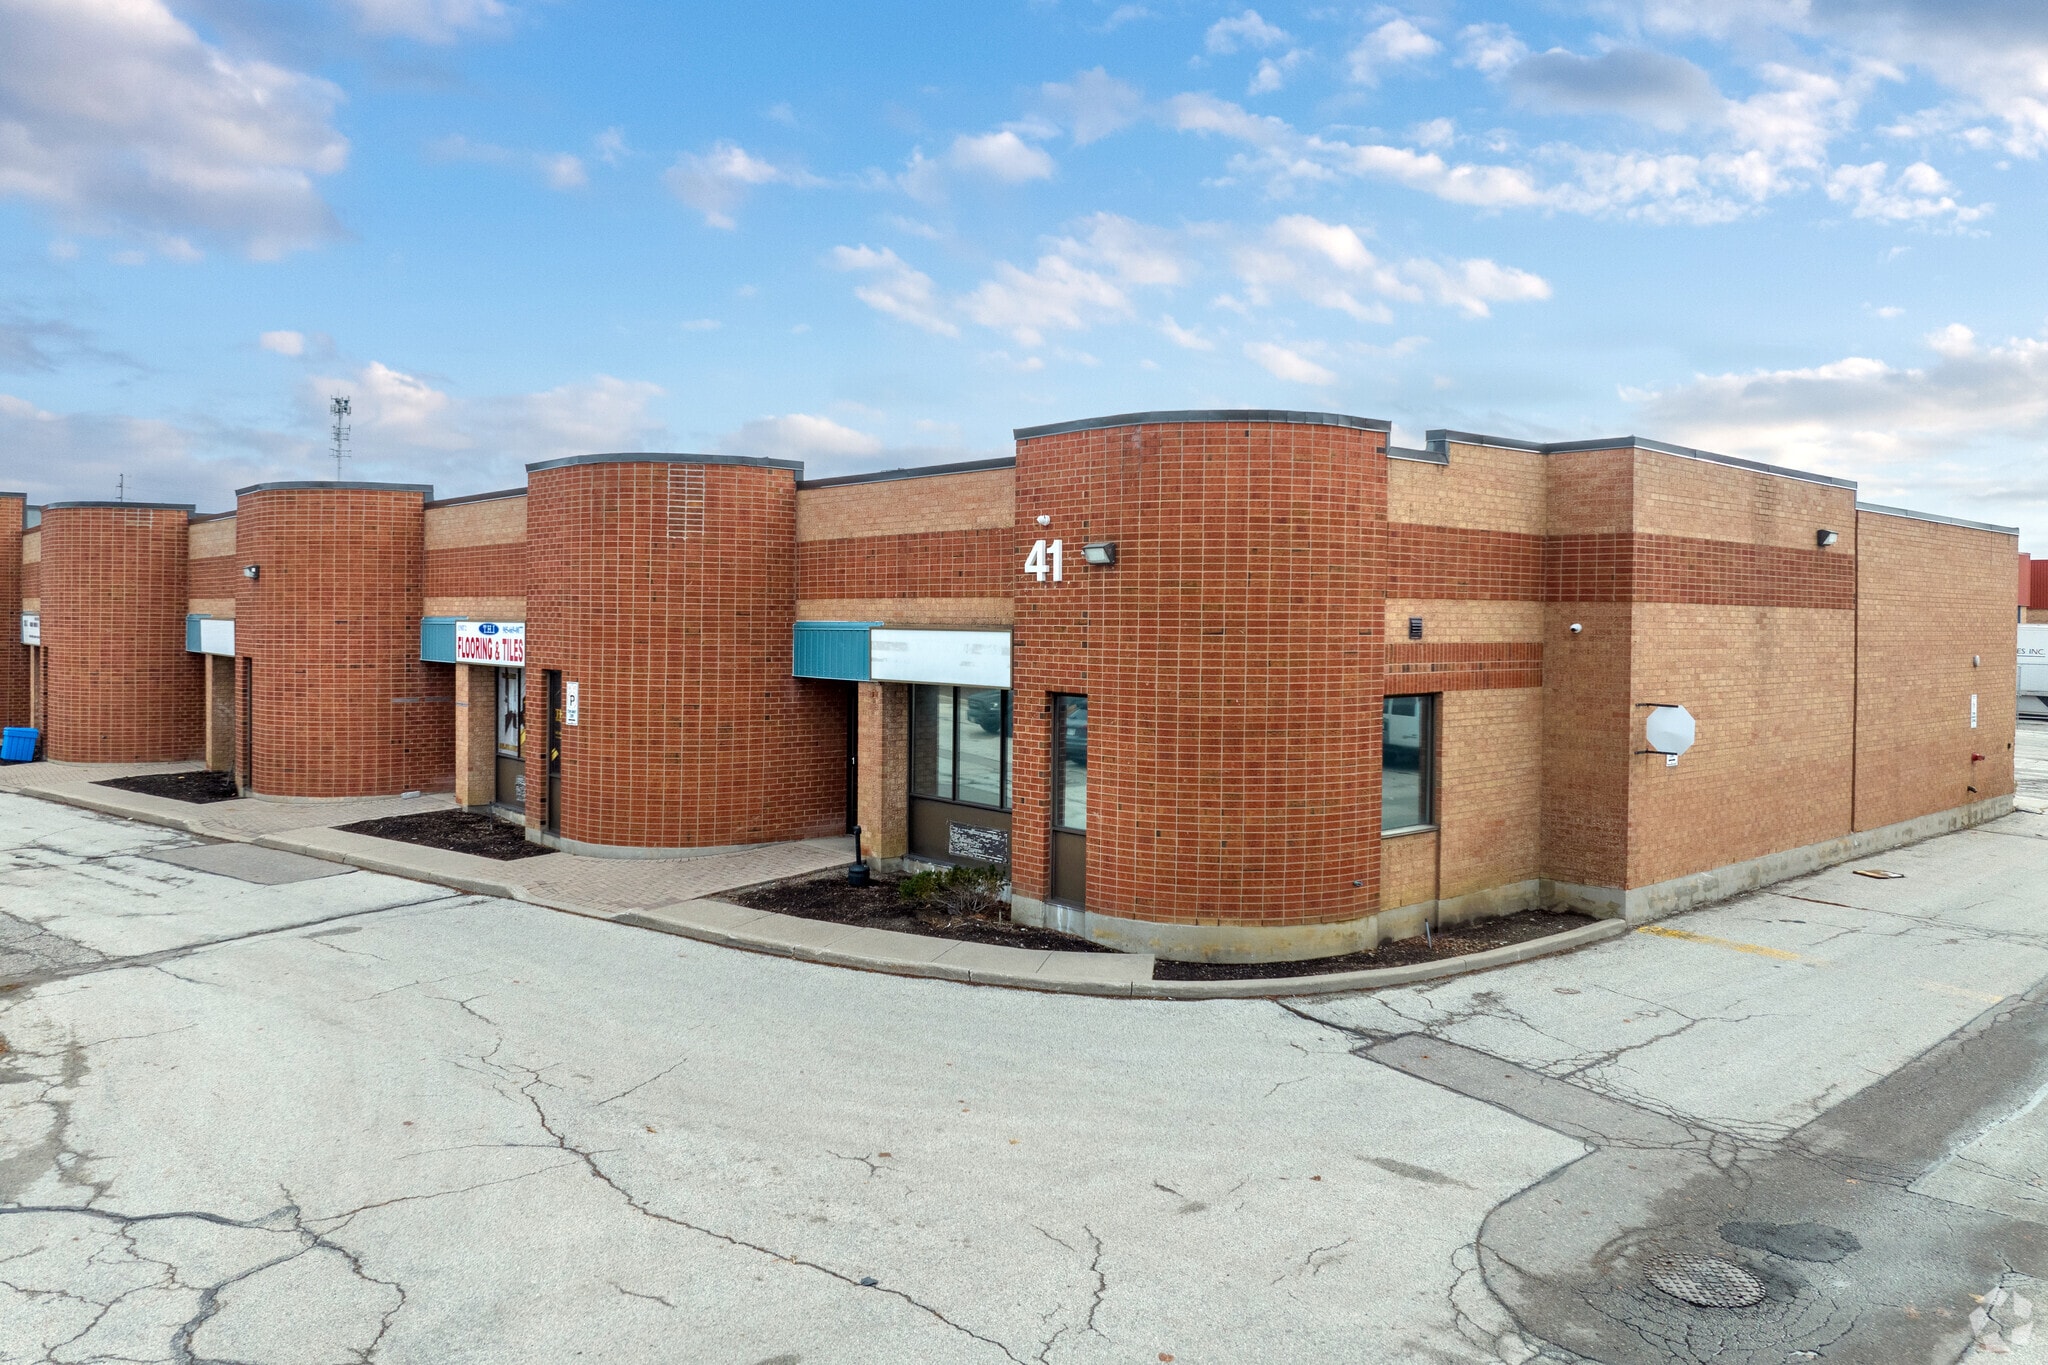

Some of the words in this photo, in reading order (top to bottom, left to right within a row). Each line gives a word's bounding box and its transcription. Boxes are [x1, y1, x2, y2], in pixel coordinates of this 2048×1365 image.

[1024, 539, 1063, 582] 41
[457, 636, 493, 661] FLOORING
[494, 641, 500, 661] &
[502, 638, 524, 662] TILES
[2029, 648, 2046, 656] INC.
[851, 756, 855, 765] 1
